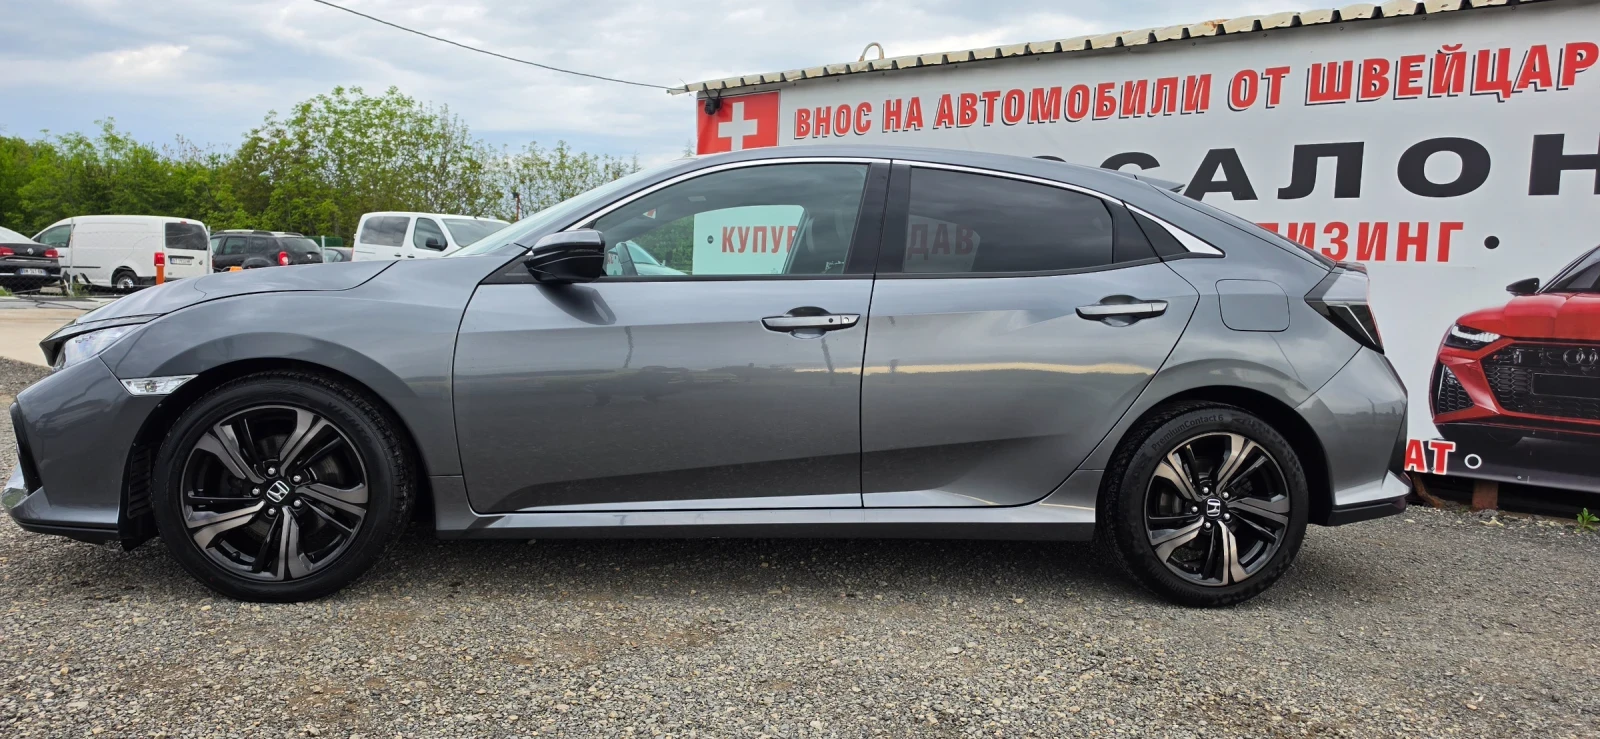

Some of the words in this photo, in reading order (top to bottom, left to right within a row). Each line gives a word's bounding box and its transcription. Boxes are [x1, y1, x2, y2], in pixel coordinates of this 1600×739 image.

[794, 100, 872, 139] ВНОС
[882, 96, 924, 132] НА
[933, 73, 1212, 129] АВТОМОБИЛИ
[1227, 66, 1290, 111] ОТ
[1305, 42, 1600, 106] ШВЕЙЦАР
[1256, 221, 1463, 263] ИЗИНГ
[1151, 414, 1217, 451] PremiumContact
